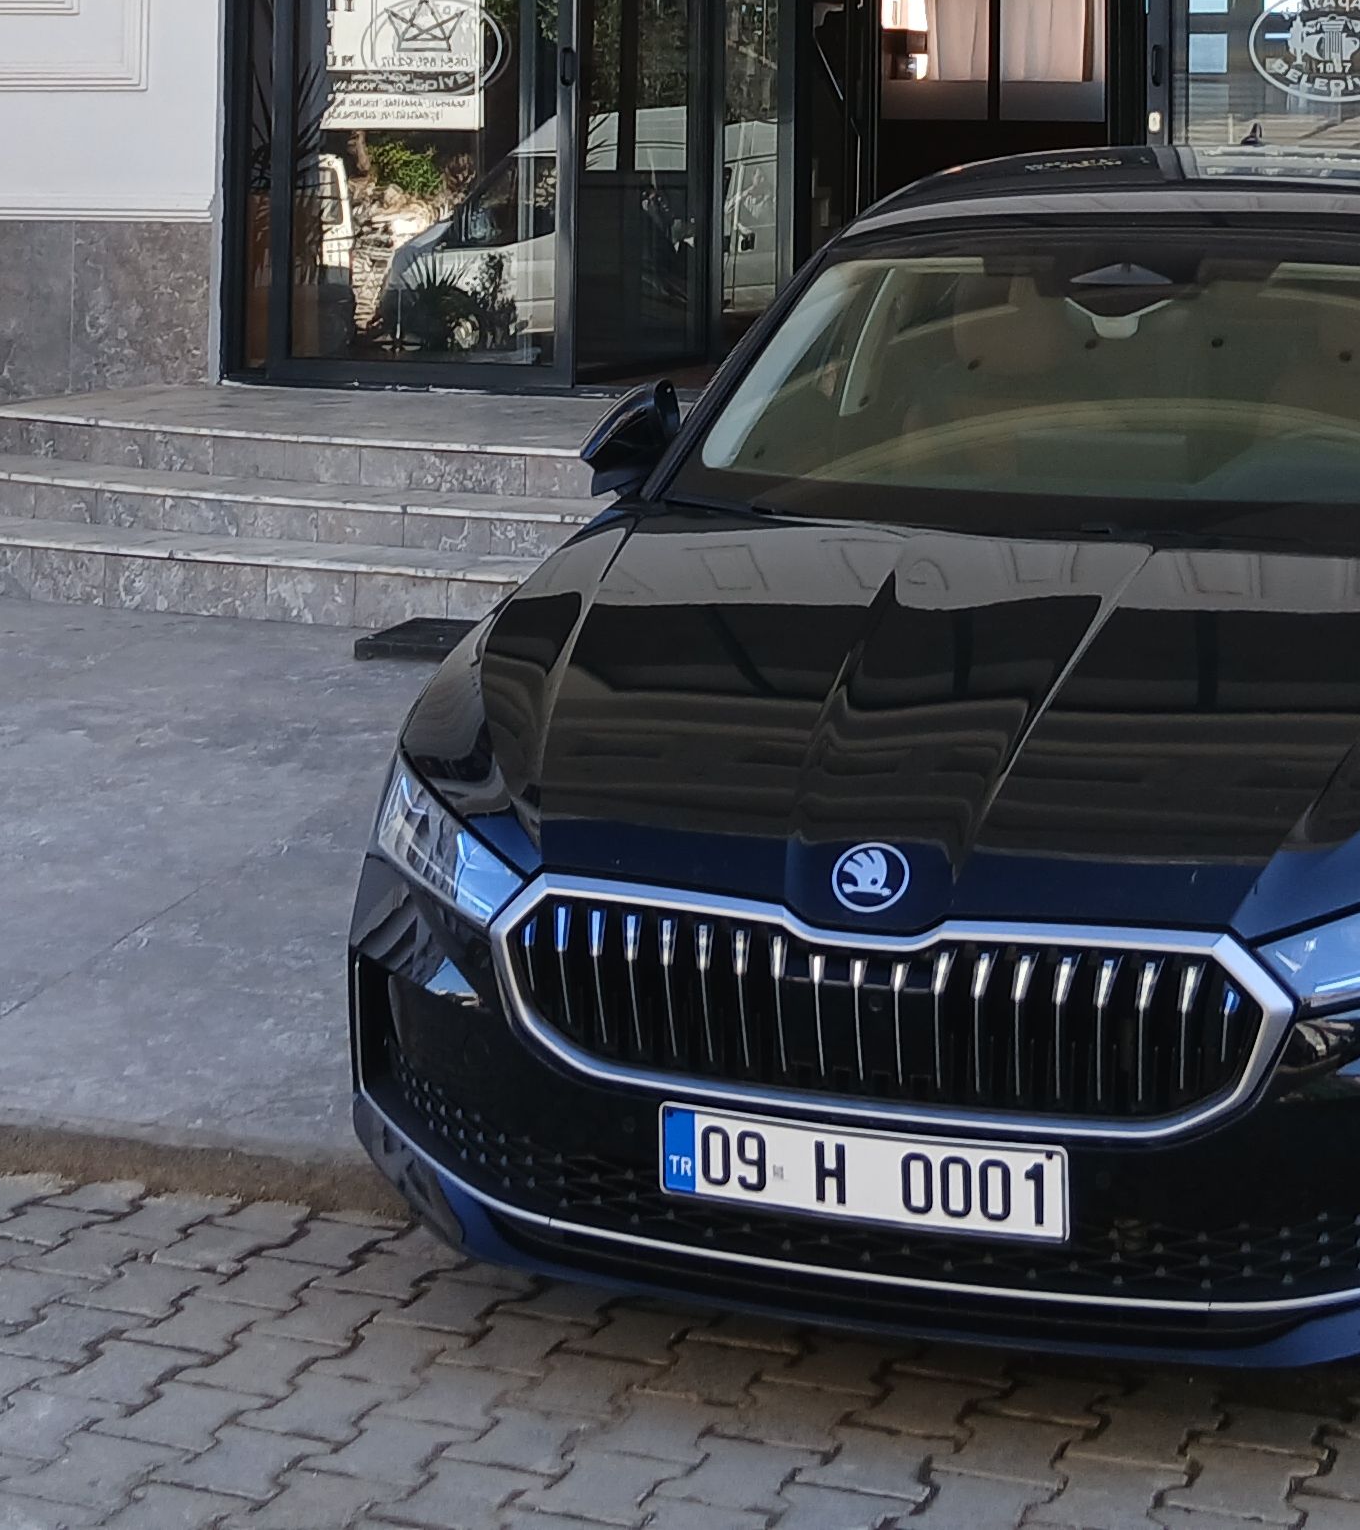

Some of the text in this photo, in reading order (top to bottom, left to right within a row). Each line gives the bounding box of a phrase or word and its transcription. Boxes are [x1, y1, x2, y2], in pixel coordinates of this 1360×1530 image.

[668, 1154, 692, 1177] TR
[700, 1124, 1045, 1227] 09 H 0001
